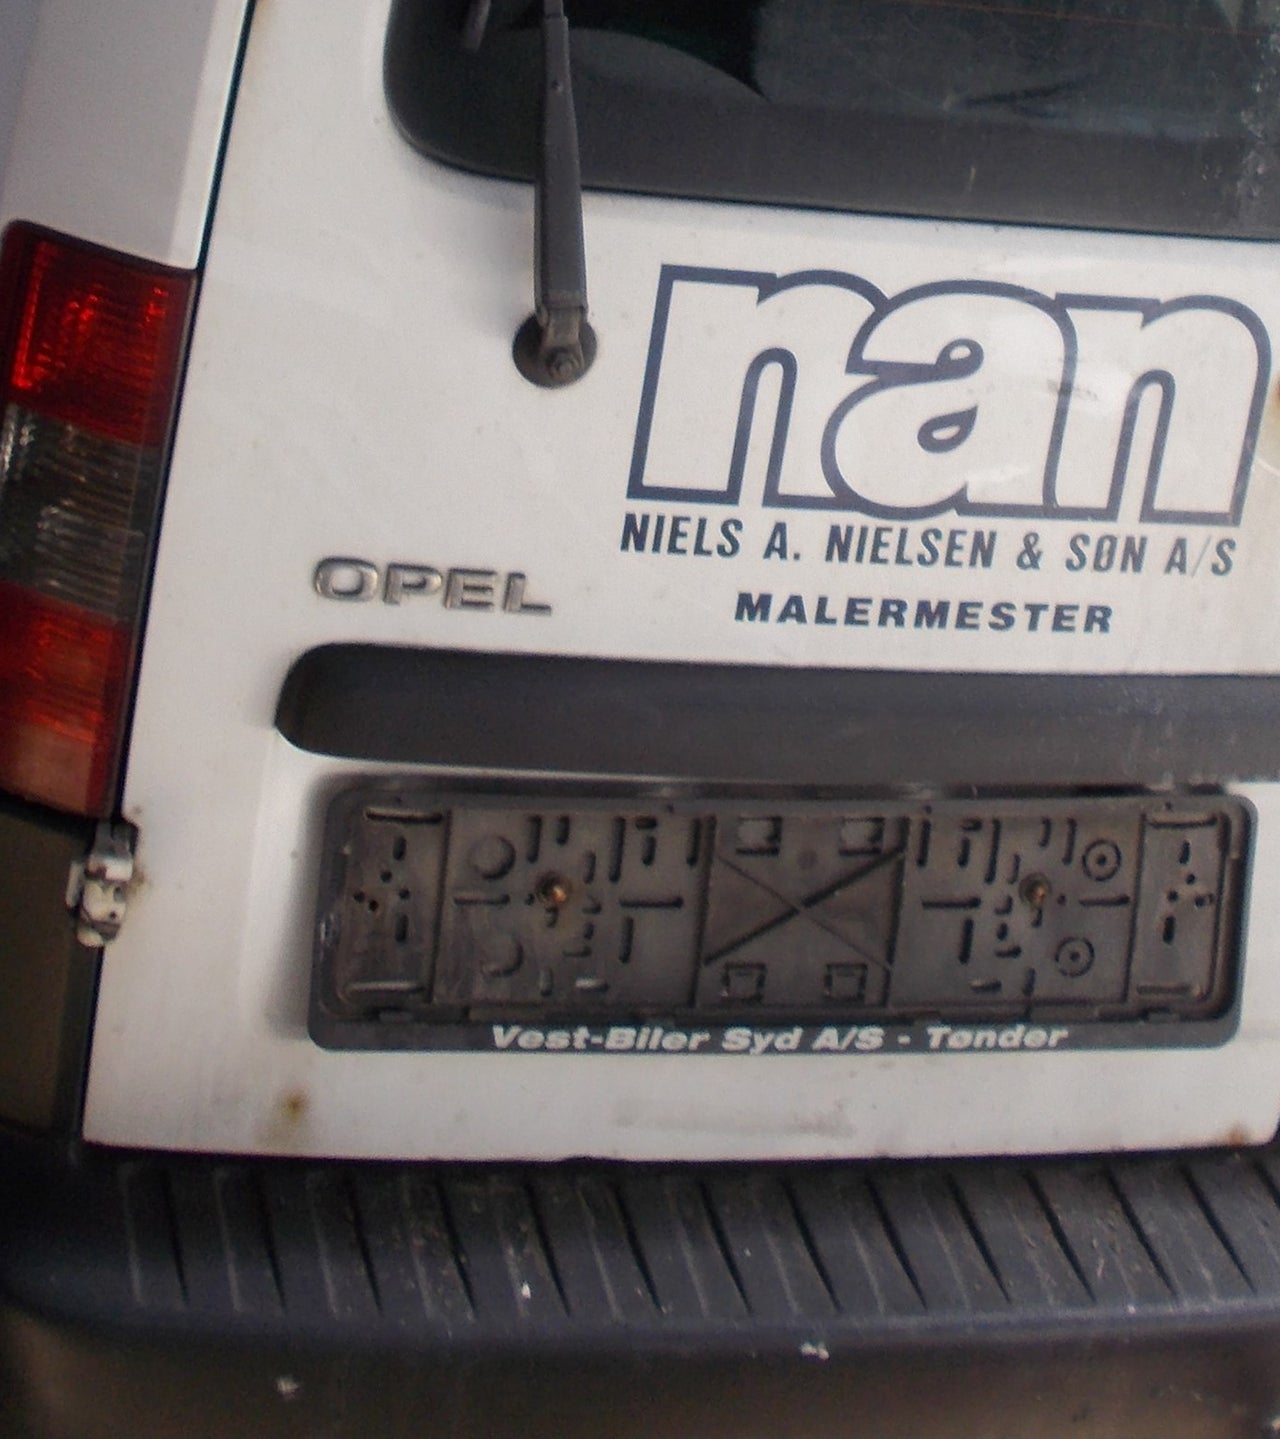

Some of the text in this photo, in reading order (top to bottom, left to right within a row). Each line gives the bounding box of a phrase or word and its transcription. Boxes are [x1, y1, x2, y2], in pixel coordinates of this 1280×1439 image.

[625, 263, 1271, 527] nan
[620, 512, 744, 560] NIELS
[763, 521, 802, 563] A.
[825, 525, 997, 570] NIELSEN
[1017, 530, 1043, 572] &
[1164, 536, 1237, 578] A/S
[314, 556, 553, 615] OPEL
[734, 593, 1113, 635] MALERMESTER
[491, 1025, 710, 1050] Vest-Biler
[721, 1026, 803, 1055] Syd
[813, 1026, 885, 1050] A/S
